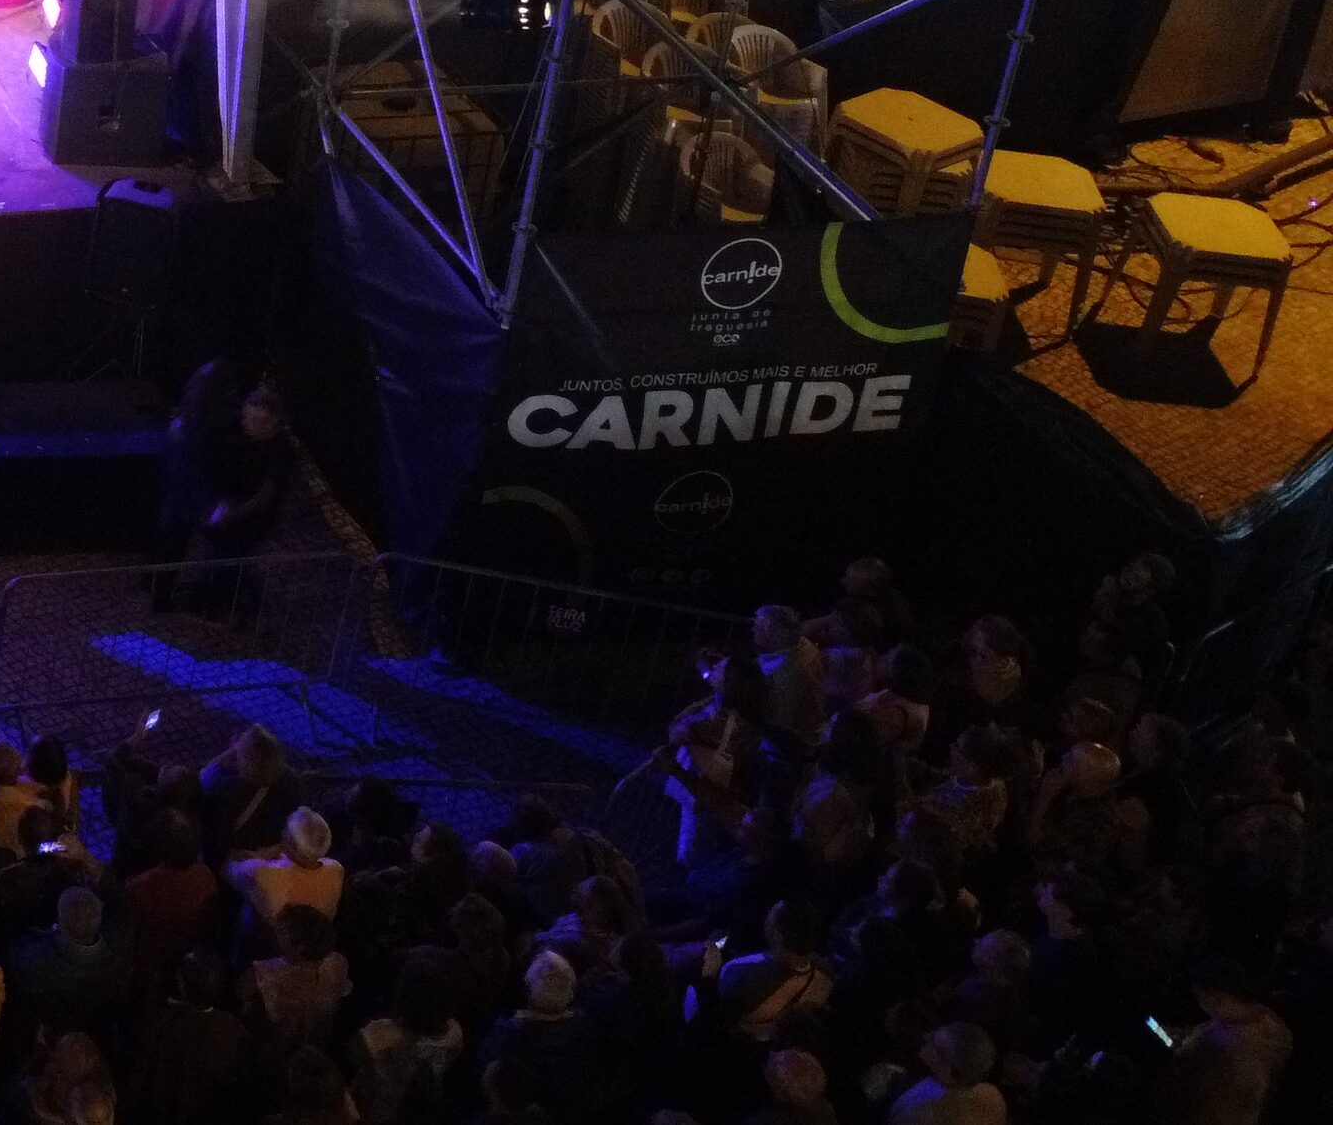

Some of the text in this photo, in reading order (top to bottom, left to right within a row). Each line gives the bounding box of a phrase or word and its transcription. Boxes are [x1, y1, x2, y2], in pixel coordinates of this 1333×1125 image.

[630, 370, 749, 389] CONSTRUÍMOS
[752, 364, 790, 379] MAIS
[793, 365, 807, 378] E
[809, 362, 878, 378] MELHOR
[507, 374, 913, 450] CARNIDE
